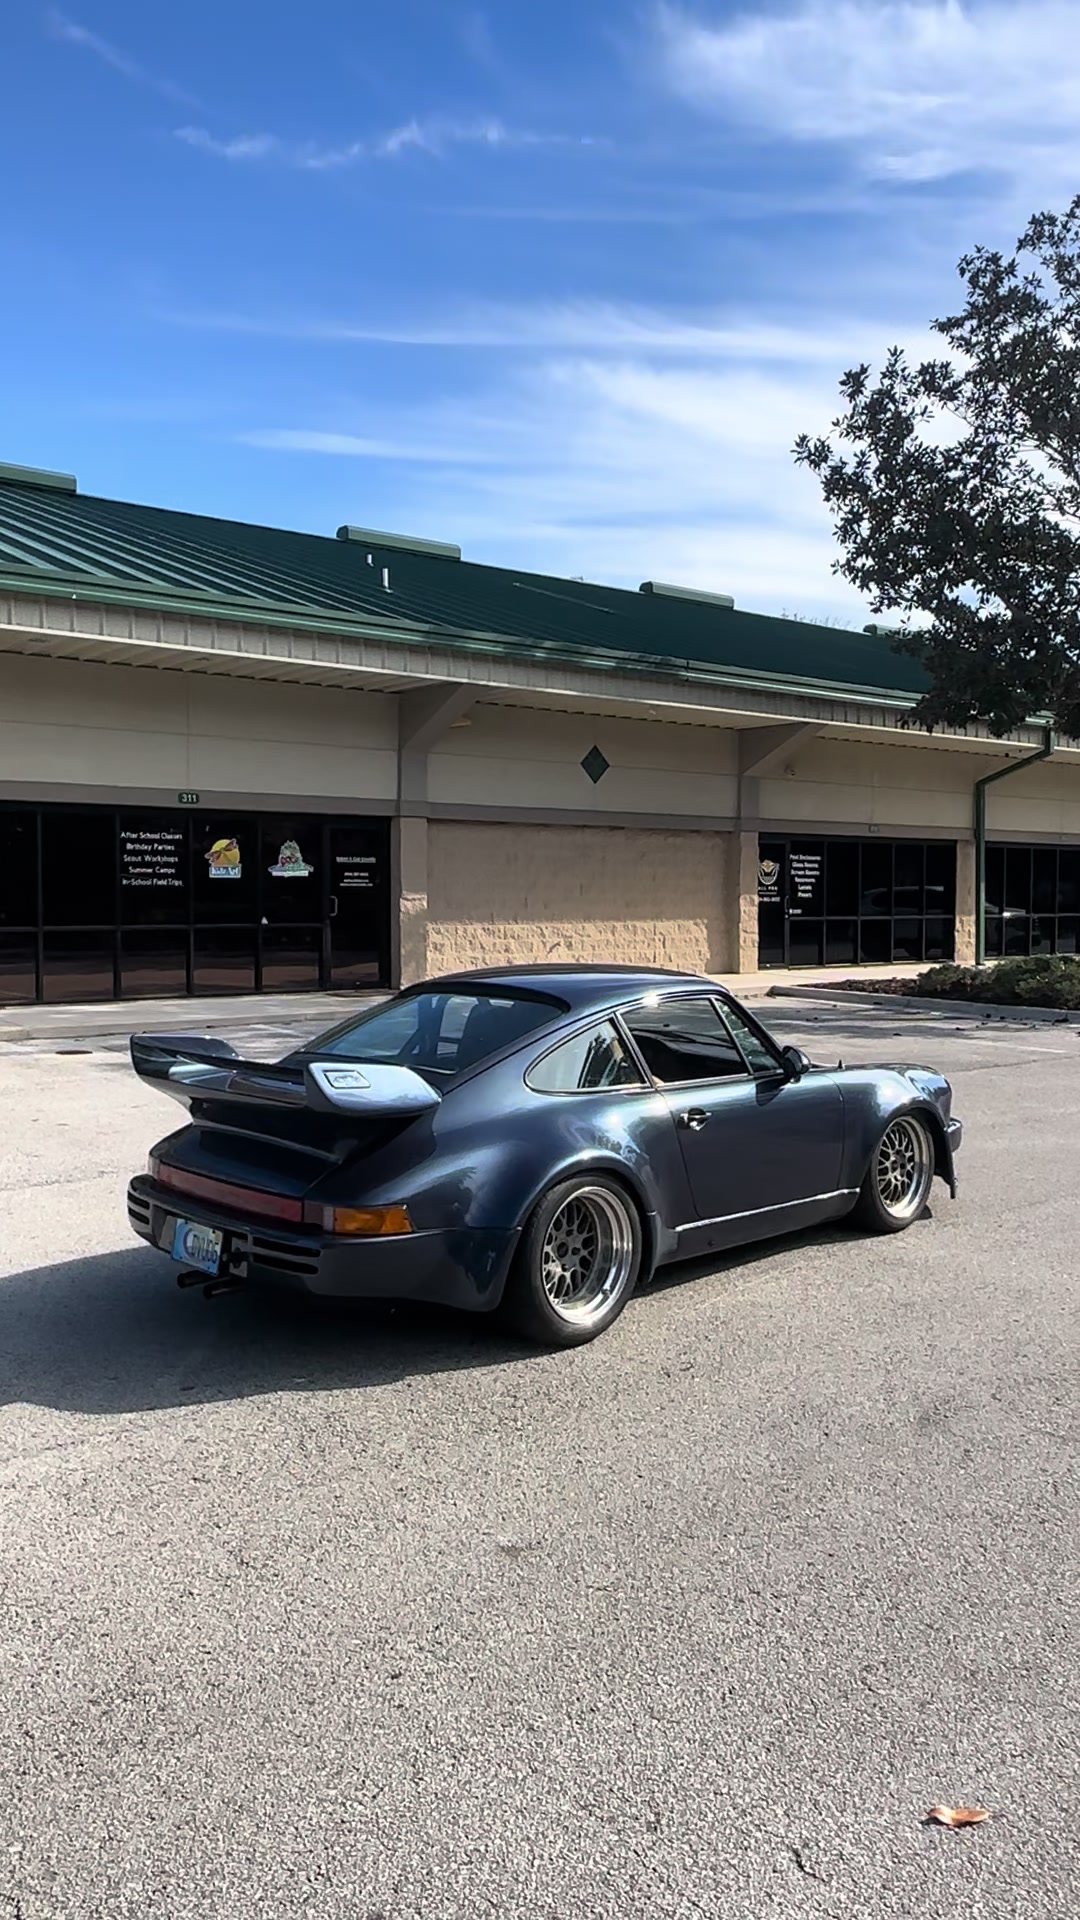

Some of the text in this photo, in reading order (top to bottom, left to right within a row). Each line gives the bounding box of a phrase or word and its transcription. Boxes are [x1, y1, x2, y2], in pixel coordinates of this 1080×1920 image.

[181, 793, 197, 803] 311
[120, 831, 183, 840] After School Classes
[126, 842, 175, 851] Birthday Parties
[123, 854, 178, 863] Scout Workshops
[128, 866, 176, 874] Summer Camps
[122, 878, 183, 886] In-School Field Trips
